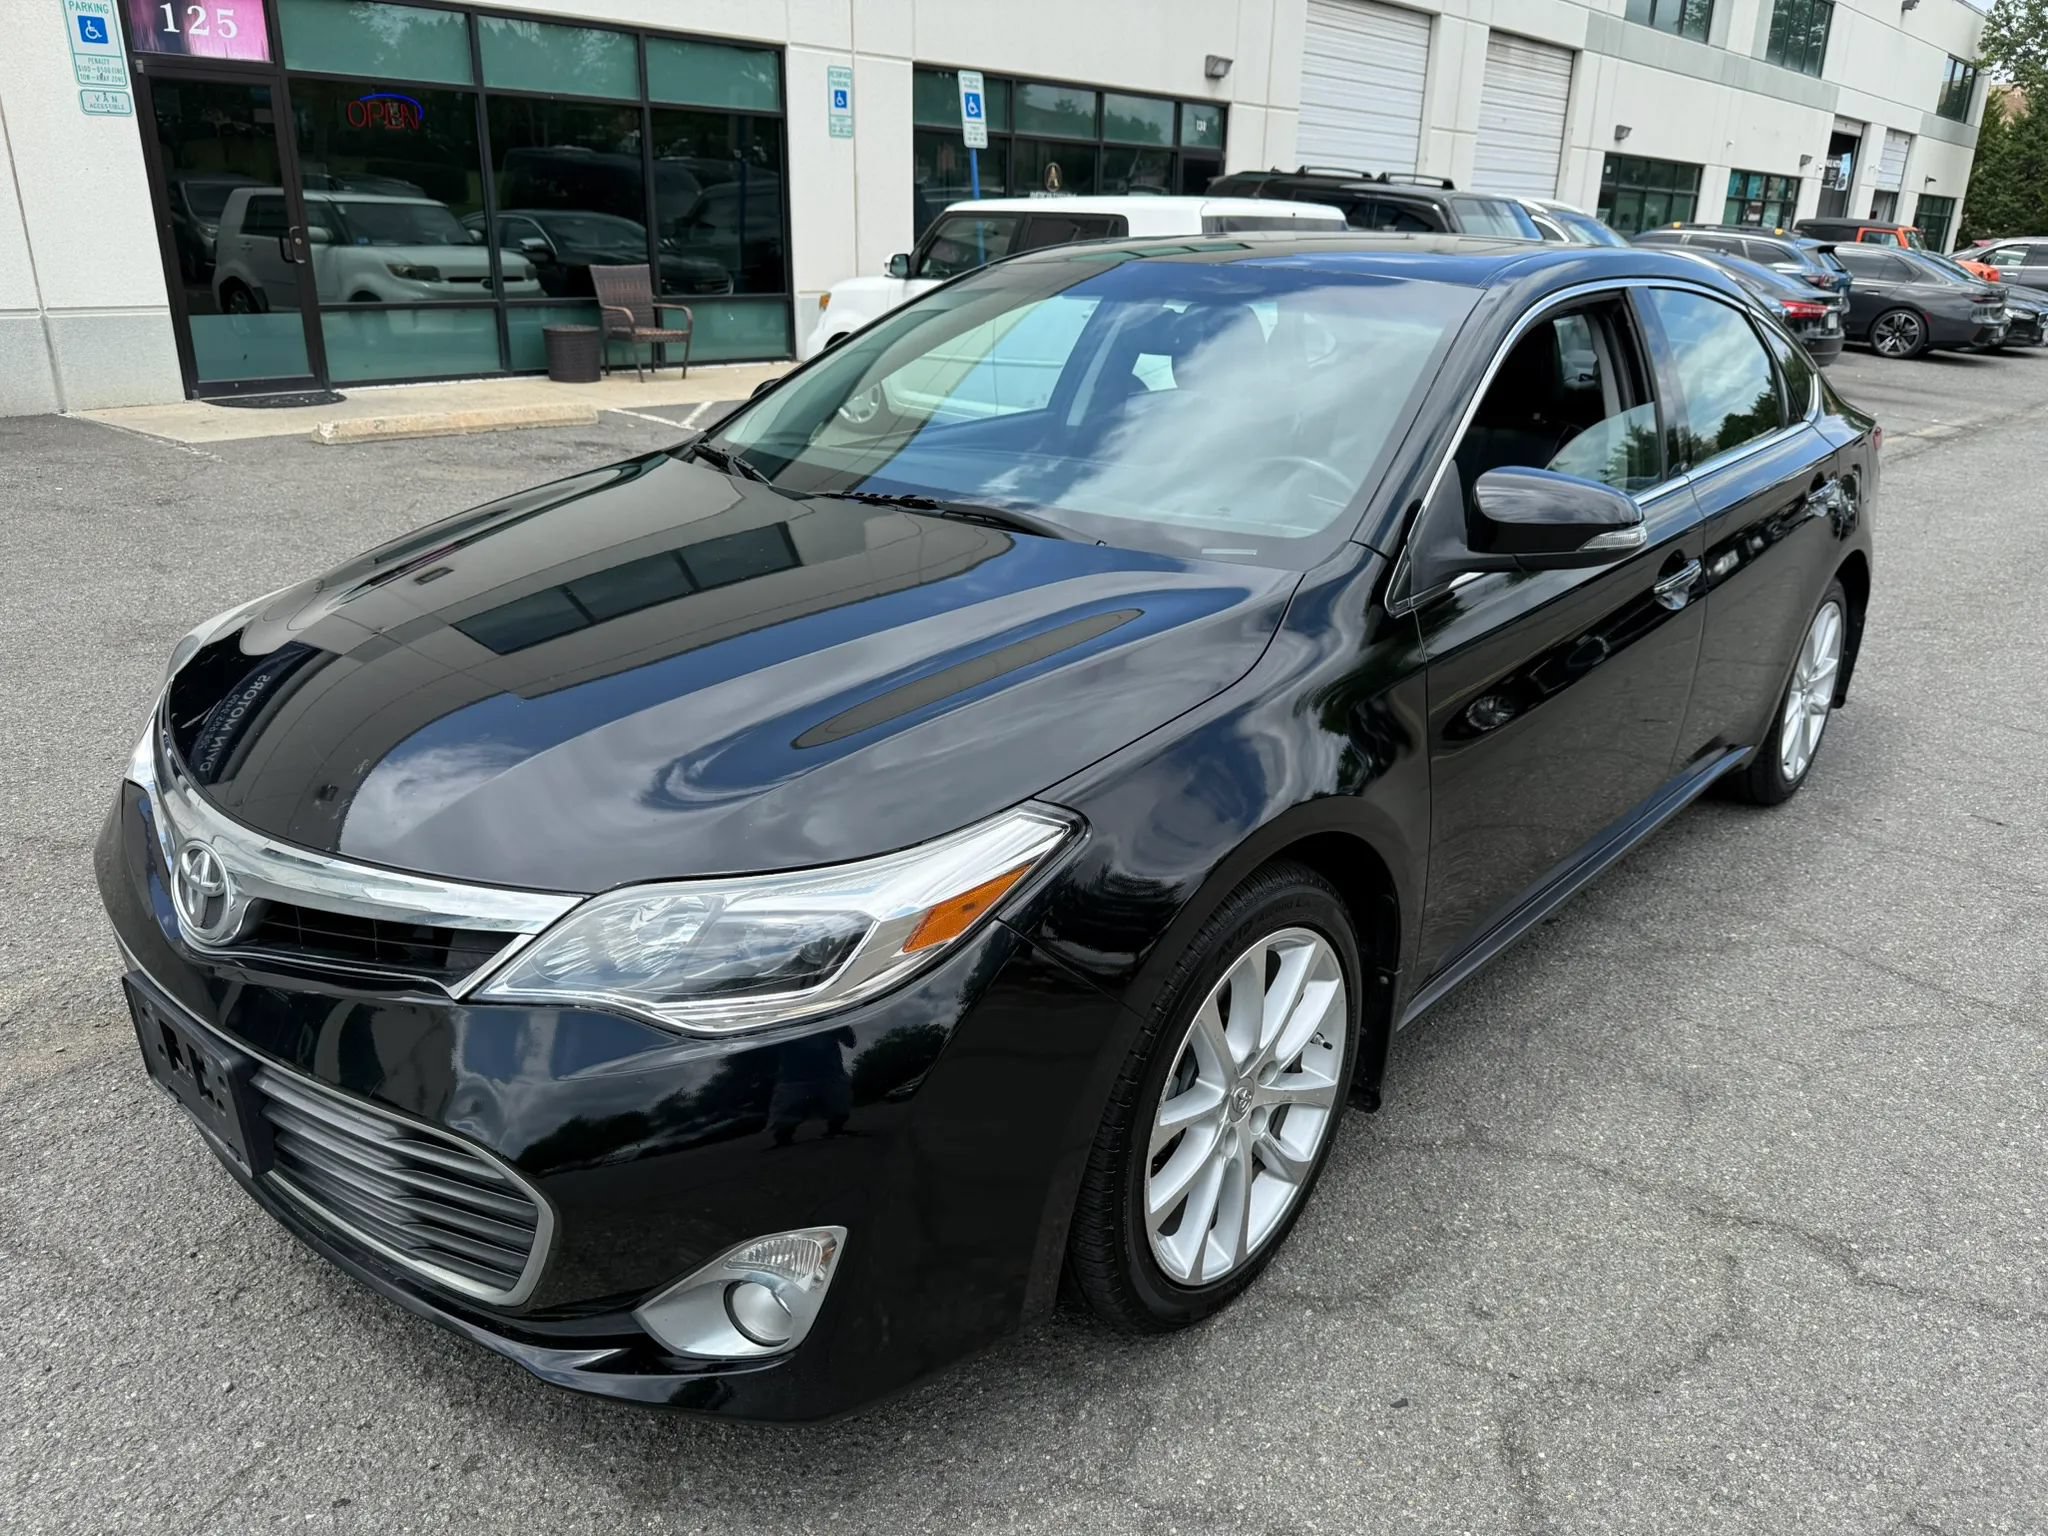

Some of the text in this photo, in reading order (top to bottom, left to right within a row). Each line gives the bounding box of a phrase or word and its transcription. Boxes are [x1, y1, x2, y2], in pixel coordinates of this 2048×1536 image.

[69, 1, 109, 14] PARKING
[160, 2, 238, 39] 125
[94, 94, 118, 102] VAN
[347, 101, 419, 129] OPEN
